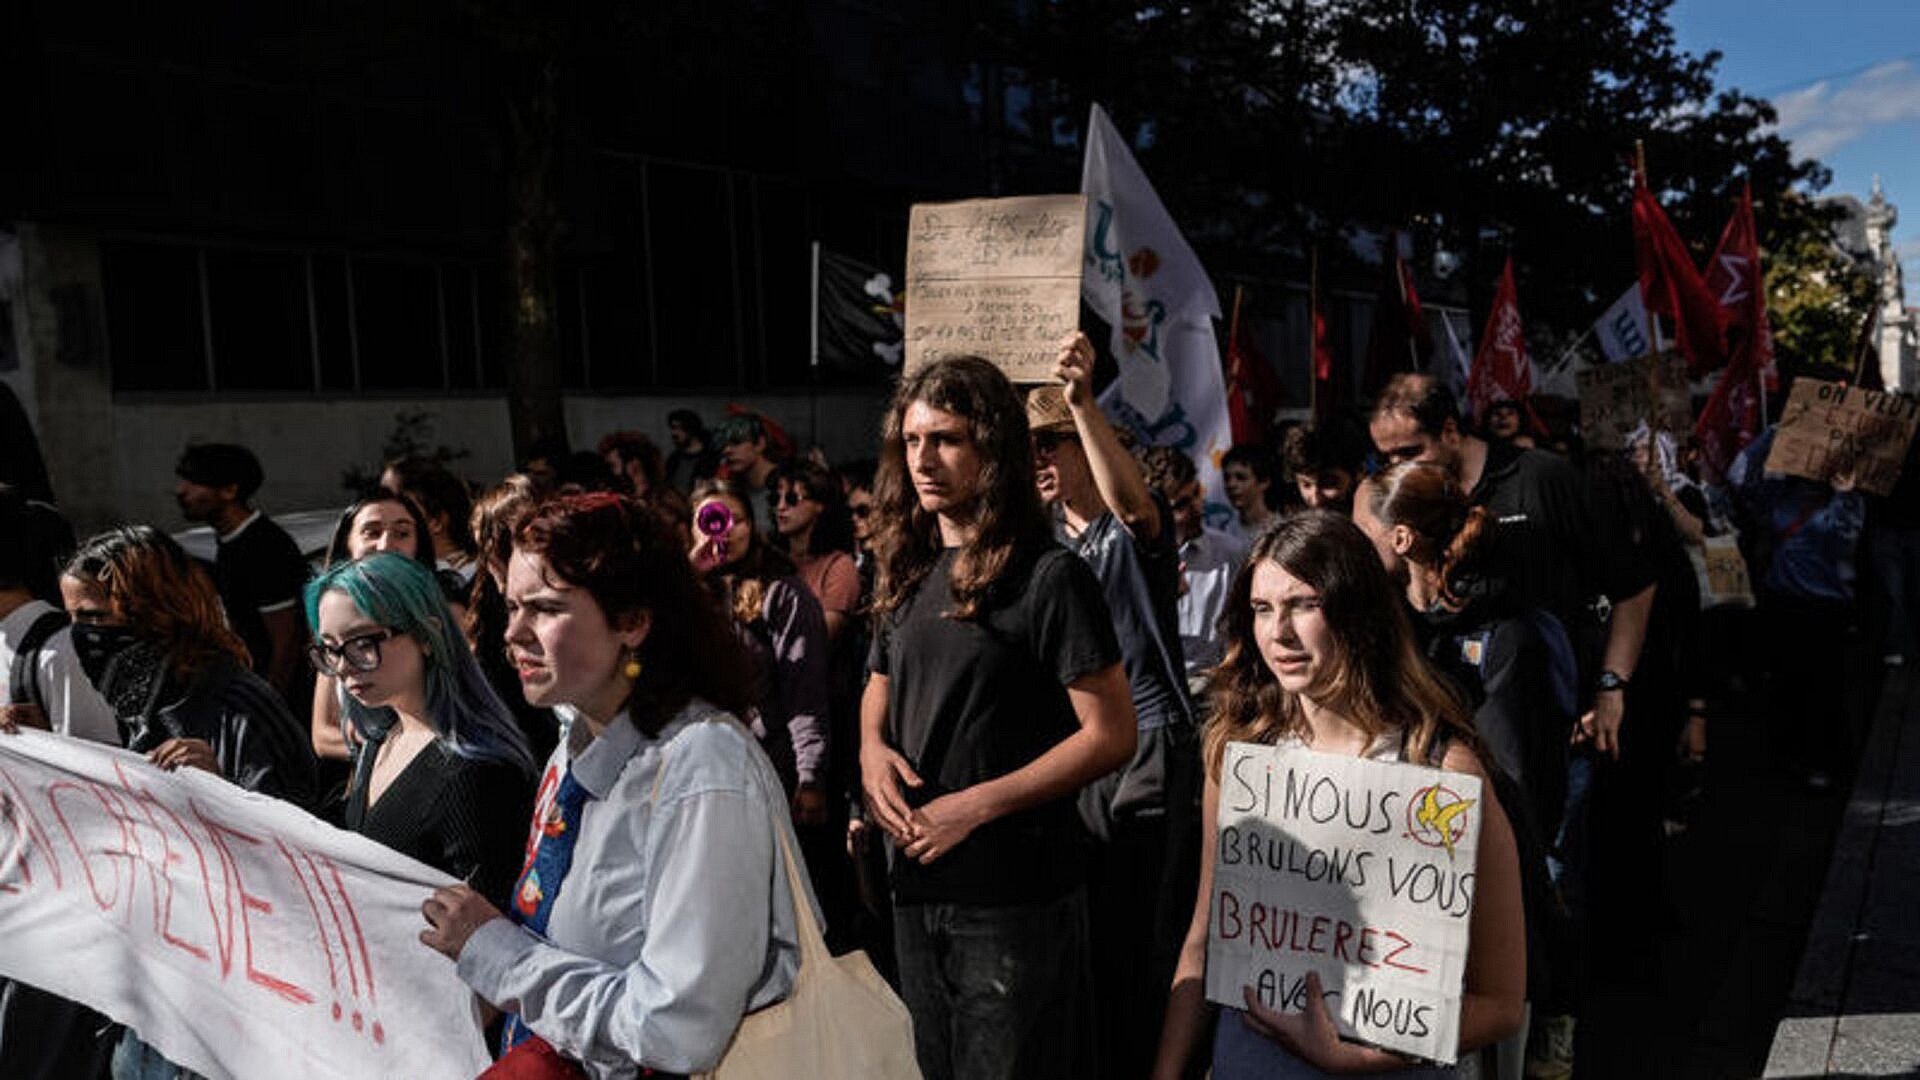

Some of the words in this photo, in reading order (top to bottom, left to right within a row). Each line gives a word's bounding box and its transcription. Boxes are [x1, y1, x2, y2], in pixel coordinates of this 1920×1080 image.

[1283, 767, 1400, 835] NOUS
[1220, 824, 1374, 887] BRULONS
[1388, 858, 1476, 918] VOUS
[1218, 890, 1429, 975] BRULEREZ
[1353, 987, 1433, 1038] NOUS
